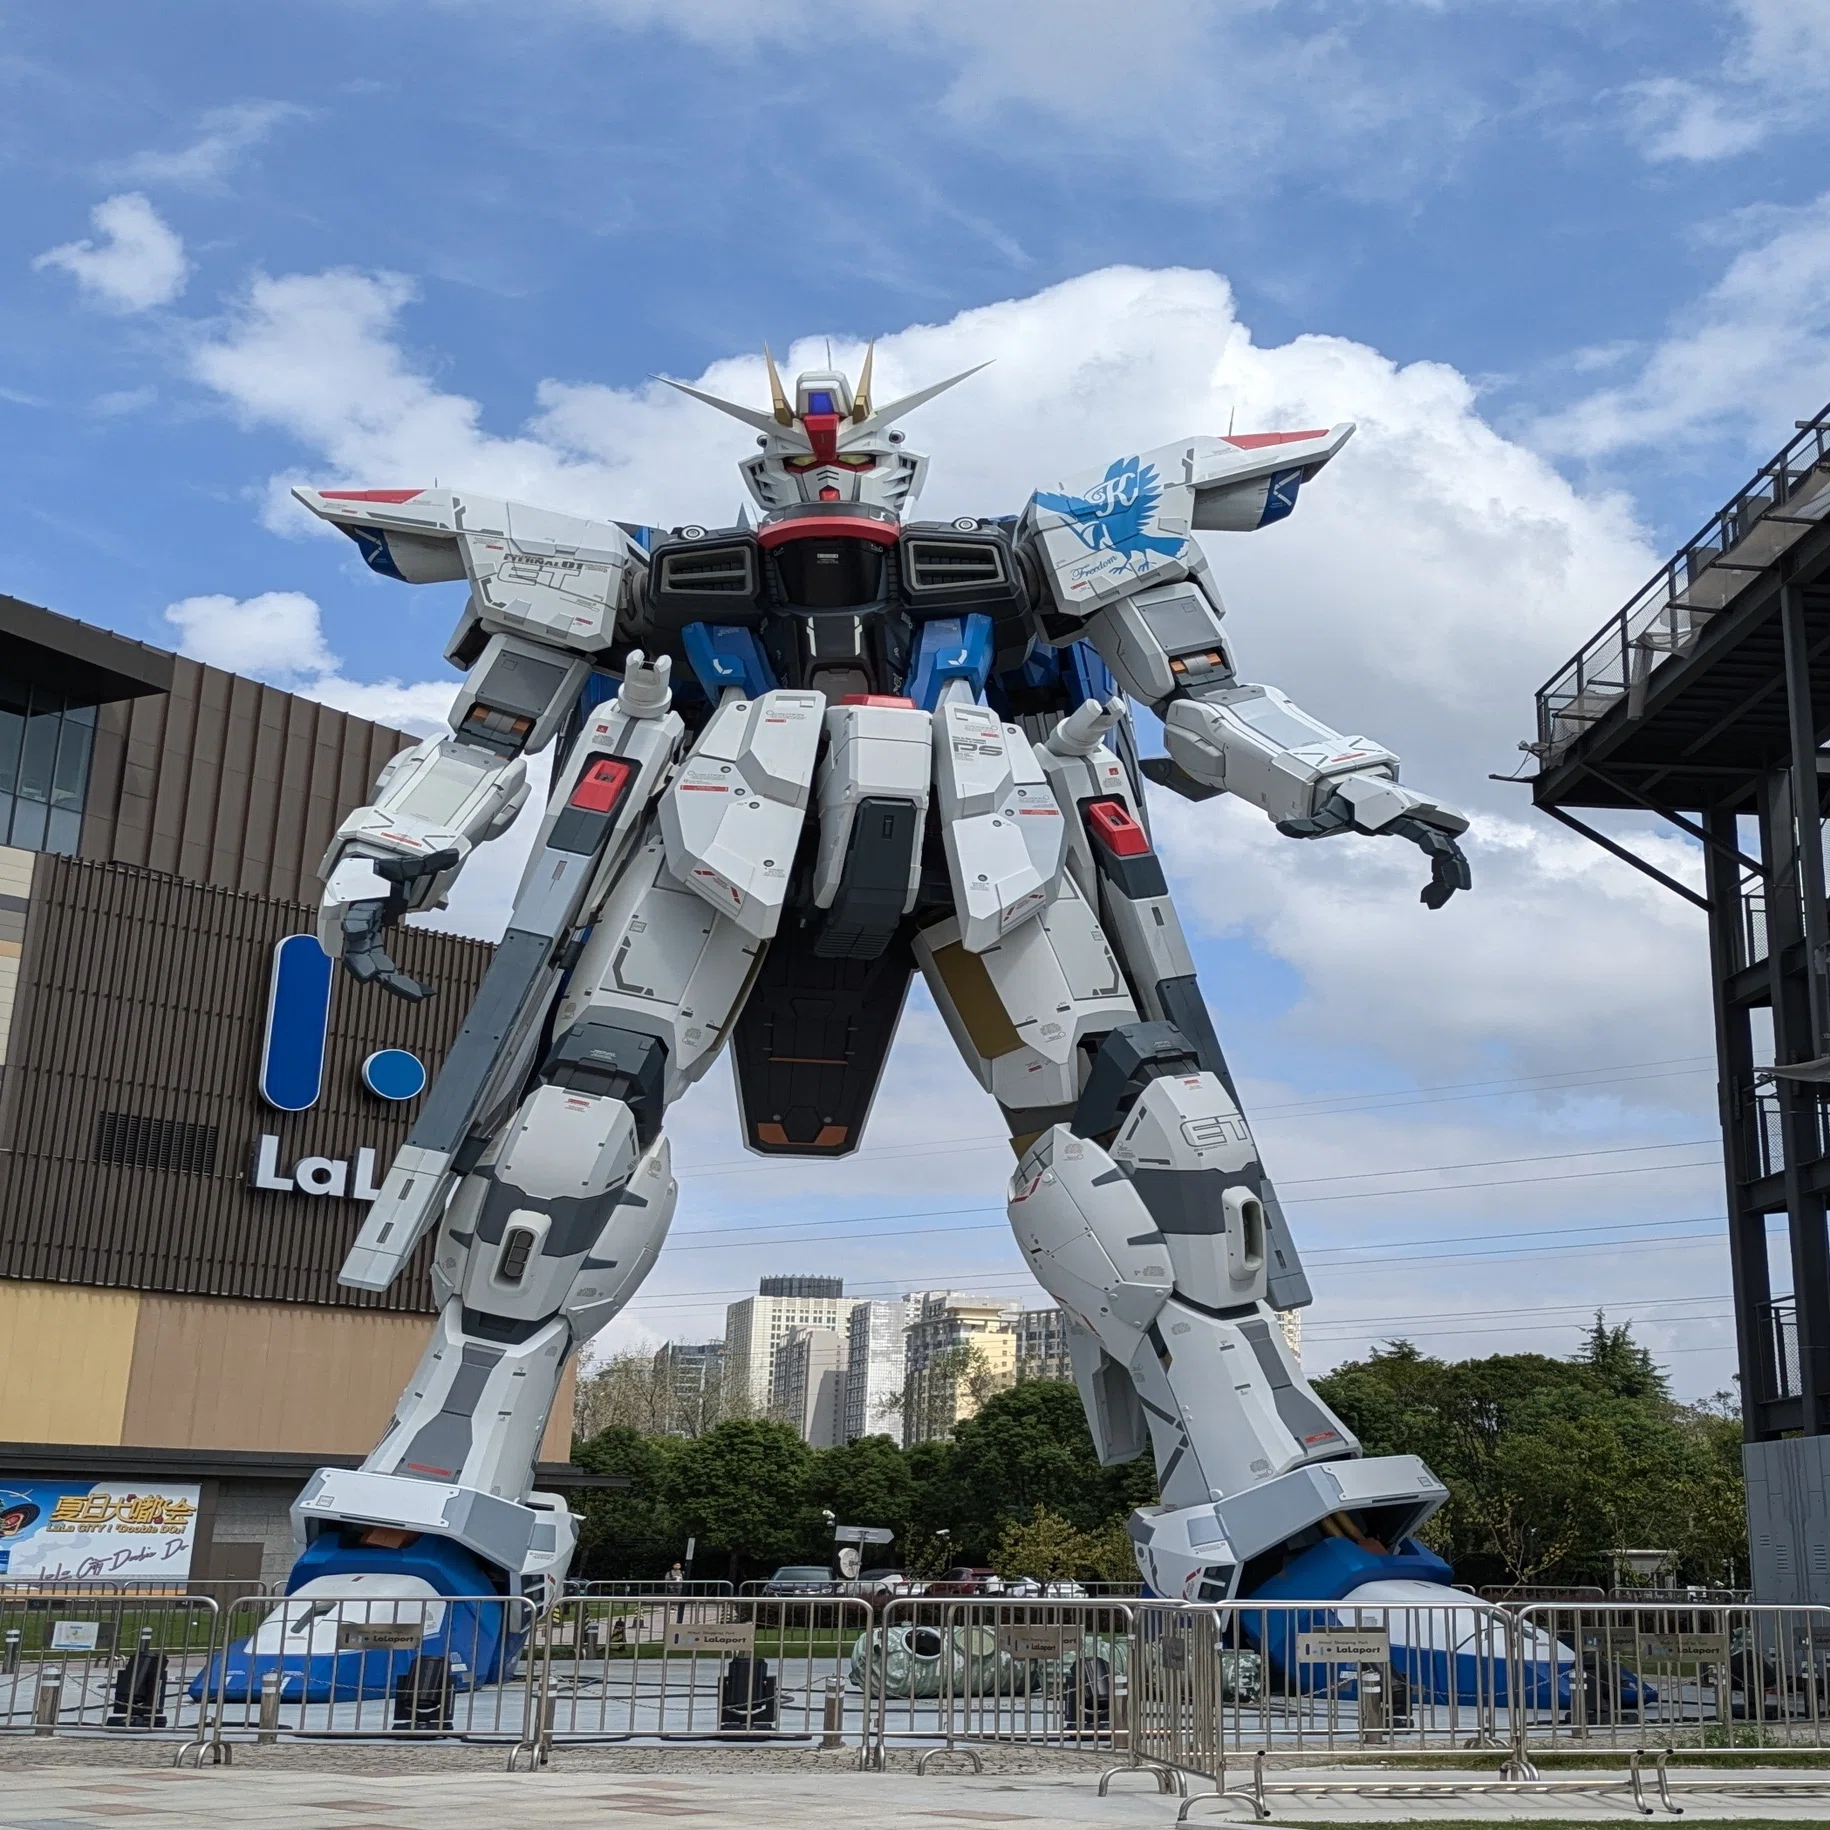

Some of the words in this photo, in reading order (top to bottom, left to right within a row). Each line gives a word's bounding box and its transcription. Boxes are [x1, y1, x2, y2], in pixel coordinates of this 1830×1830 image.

[1070, 555, 1117, 581] Freedom
[953, 741, 1003, 756] PS
[52, 1493, 196, 1524] 夏日大嘟会
[373, 1635, 414, 1644] LaLaport
[704, 1635, 747, 1645] LaLaport
[1031, 1643, 1056, 1652] LaLaport
[1336, 1645, 1381, 1655] LaLaport
[1677, 1647, 1720, 1656] LaLaport
